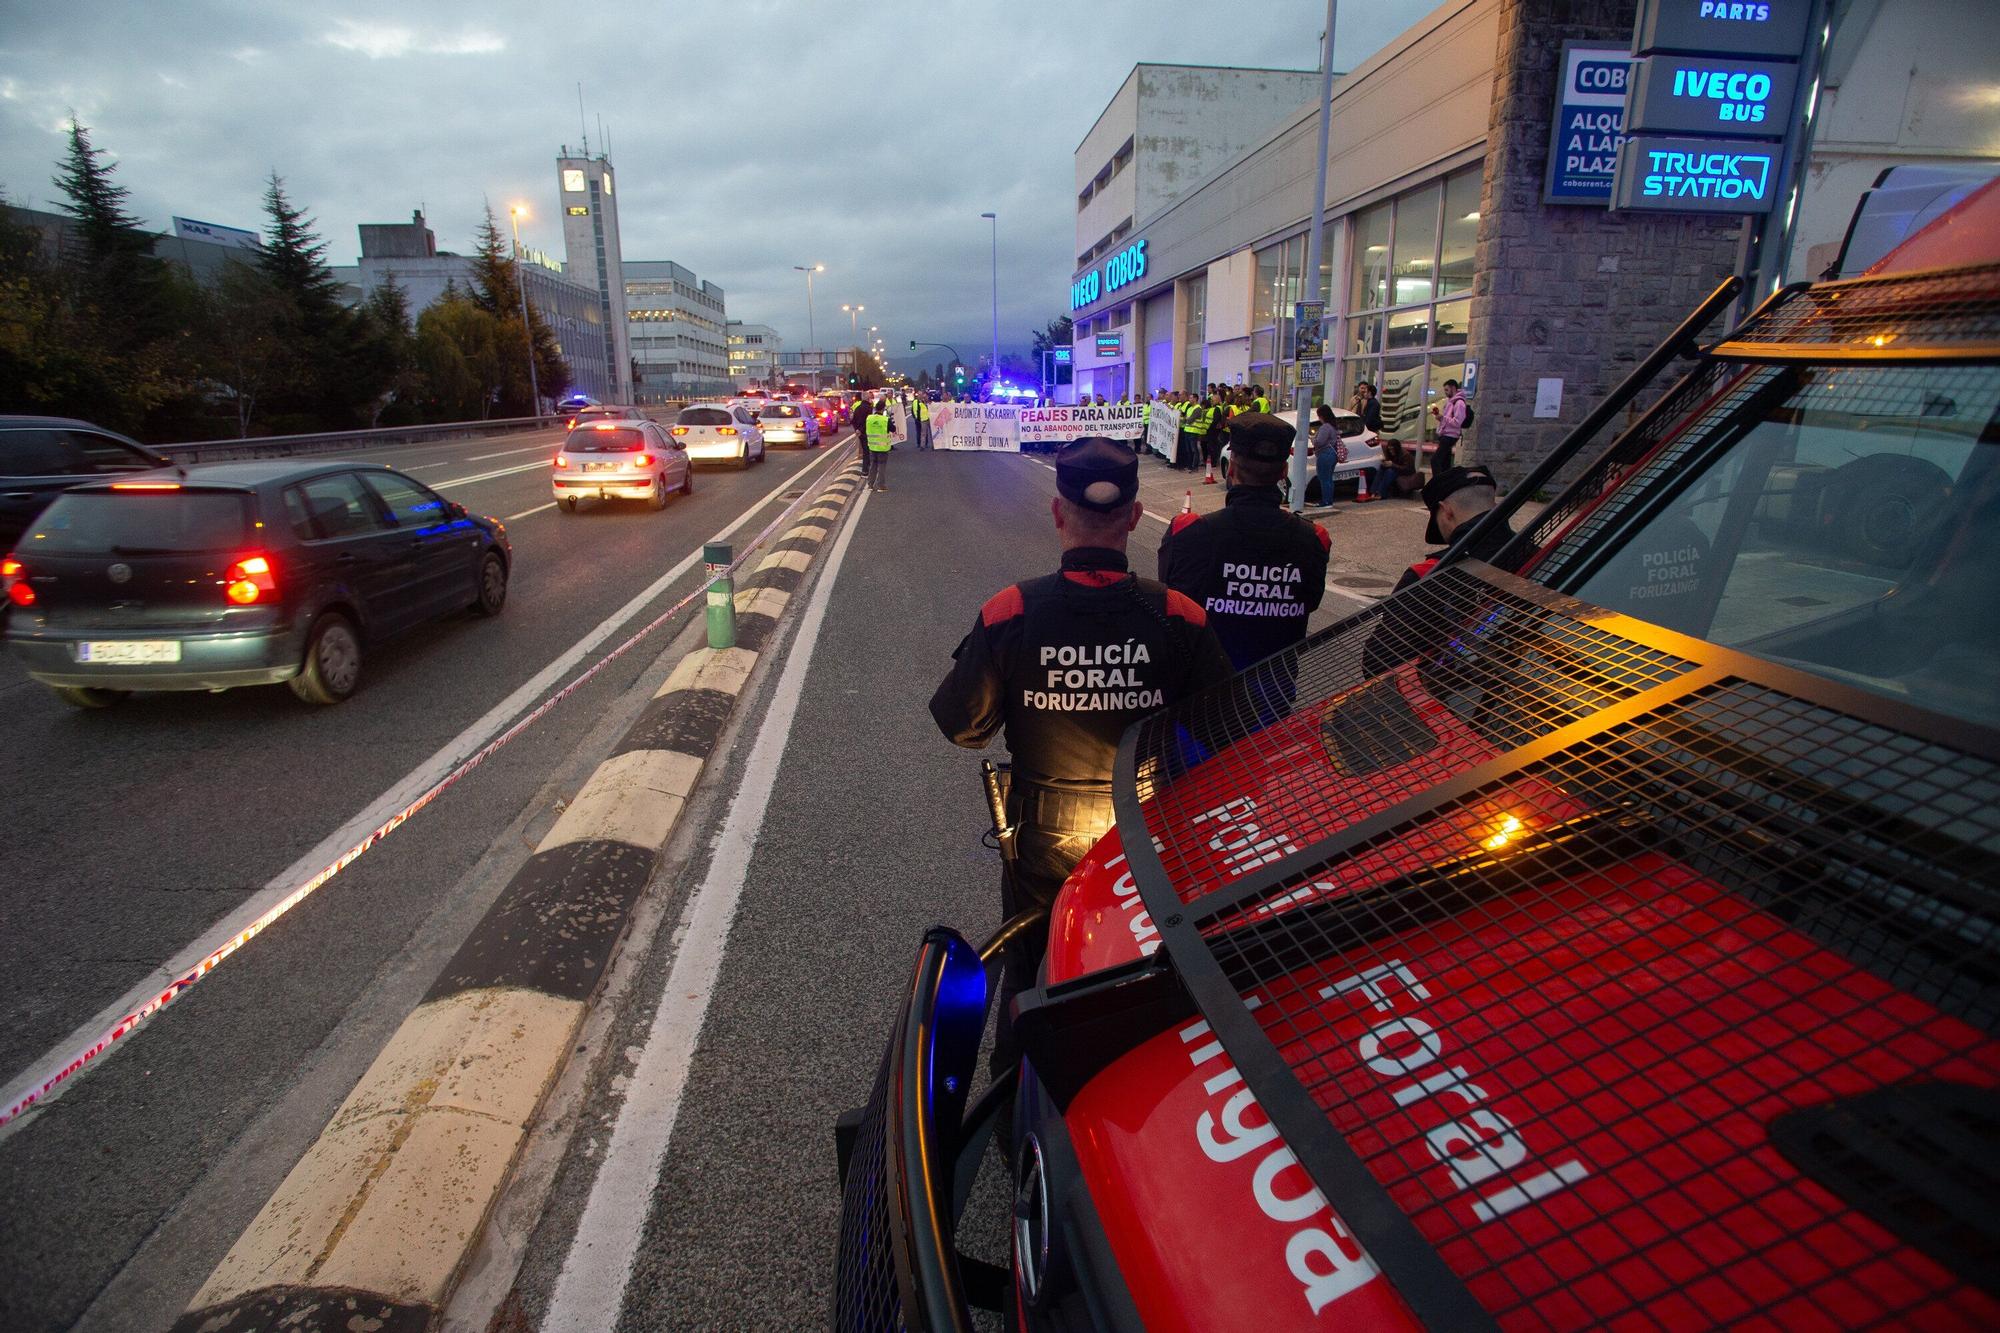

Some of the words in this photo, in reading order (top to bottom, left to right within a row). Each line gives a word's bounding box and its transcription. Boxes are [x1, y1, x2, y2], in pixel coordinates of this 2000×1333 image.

[1700, 1, 1769, 21] PARTS
[1580, 67, 1630, 88] COB
[1673, 70, 1771, 102] IVECO
[1719, 103, 1766, 122] BUS
[1568, 135, 1582, 151] A
[1648, 151, 1743, 176] TRUCK
[1643, 175, 1770, 200] STATION
[1071, 269, 1101, 311] IVECO
[1105, 239, 1147, 293] COBOS
[1463, 363, 1476, 388] P
[1021, 409, 1069, 423] PEAJES
[1072, 408, 1105, 421] PARA
[1107, 406, 1144, 420] NADIE
[1021, 425, 1031, 433] NO
[1033, 424, 1043, 433] AL
[1044, 424, 1083, 432] ABANDONO
[1084, 424, 1098, 432] DEL
[1099, 421, 1143, 432] TRANSPORTE
[1222, 562, 1302, 583] POLICÍA
[1647, 564, 1698, 582] FORAL
[1226, 581, 1295, 600] FORAL
[1205, 597, 1305, 617] FORUZAINGOA
[1040, 638, 1151, 666] POLICÍA
[1047, 668, 1144, 689] FORAL
[1023, 689, 1164, 712] FORUZAINGOA
[1318, 958, 1590, 1224] Foral
